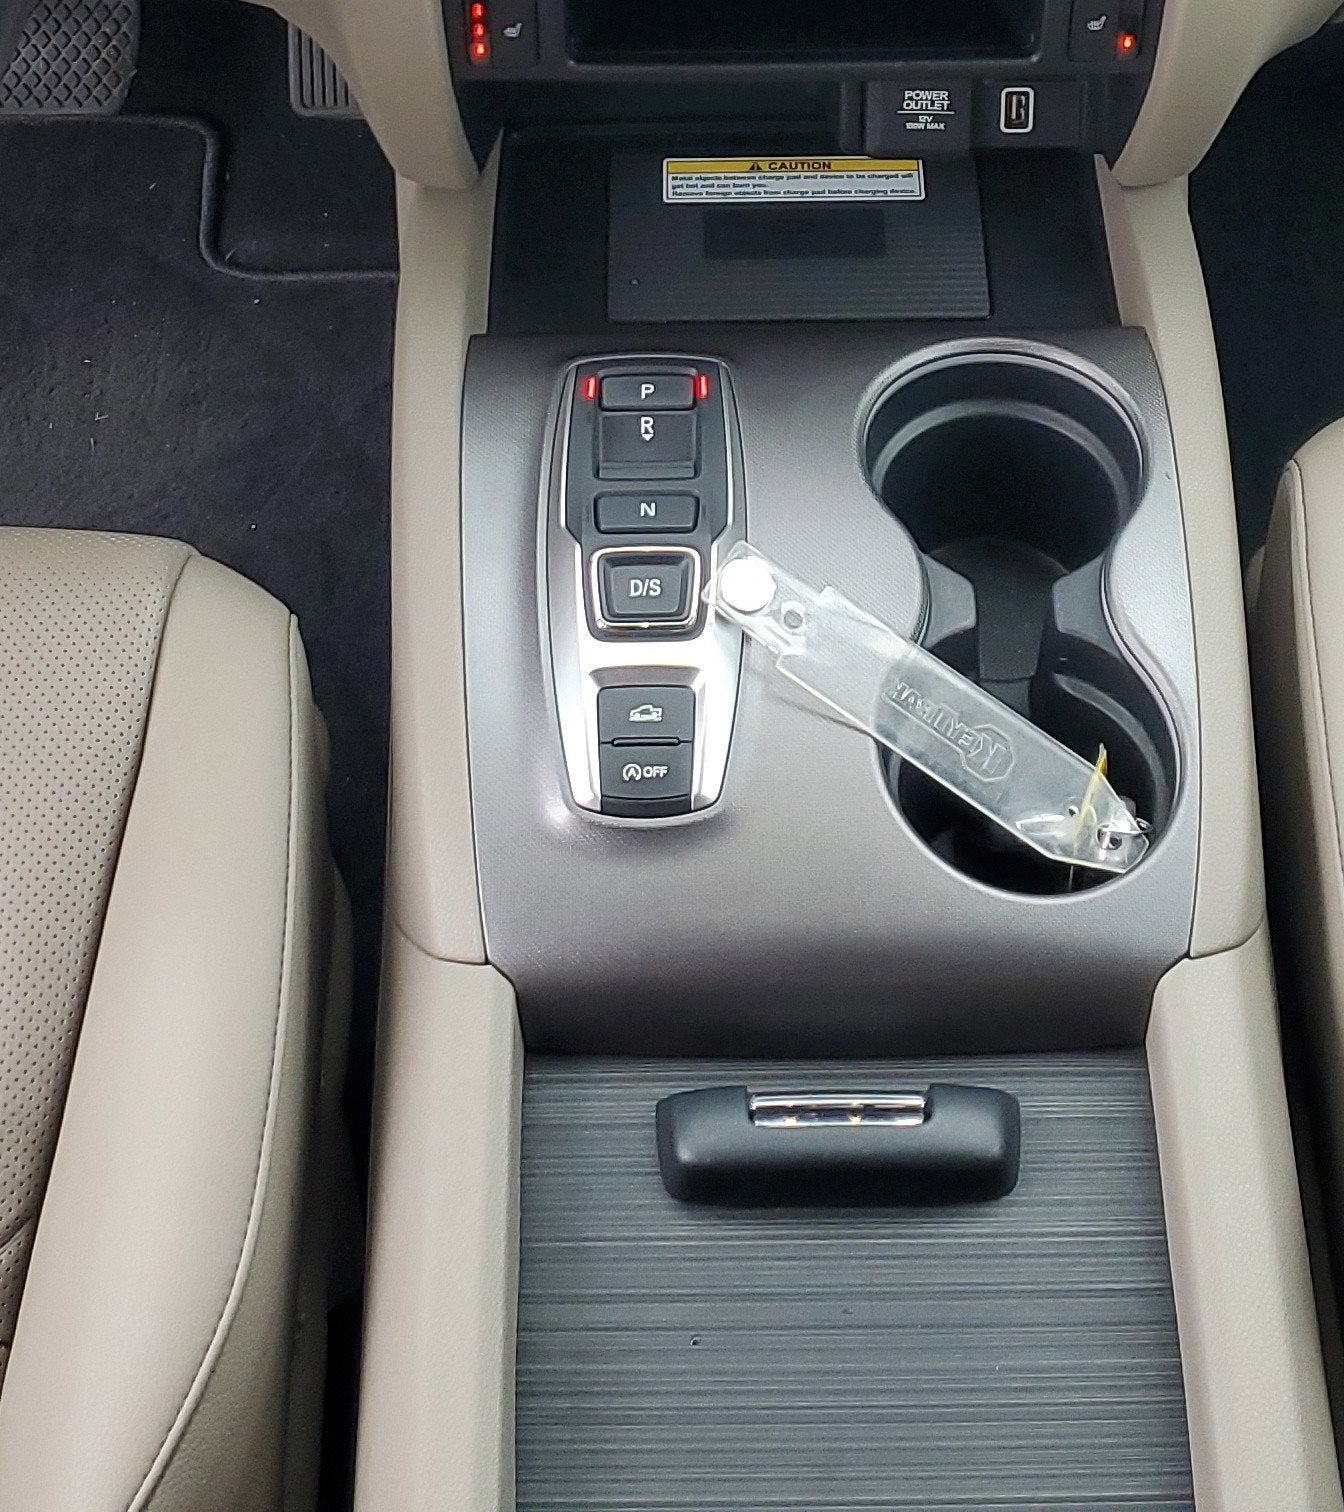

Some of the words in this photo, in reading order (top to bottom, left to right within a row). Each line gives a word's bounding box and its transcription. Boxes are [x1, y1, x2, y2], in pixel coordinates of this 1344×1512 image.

[904, 90, 949, 100] POWER
[902, 100, 951, 111] OUTLET
[768, 161, 832, 171] CAUTION
[640, 383, 655, 400] P
[640, 416, 654, 434] R
[640, 502, 656, 517] N
[628, 578, 662, 597] D/S
[642, 765, 668, 779] OFF
